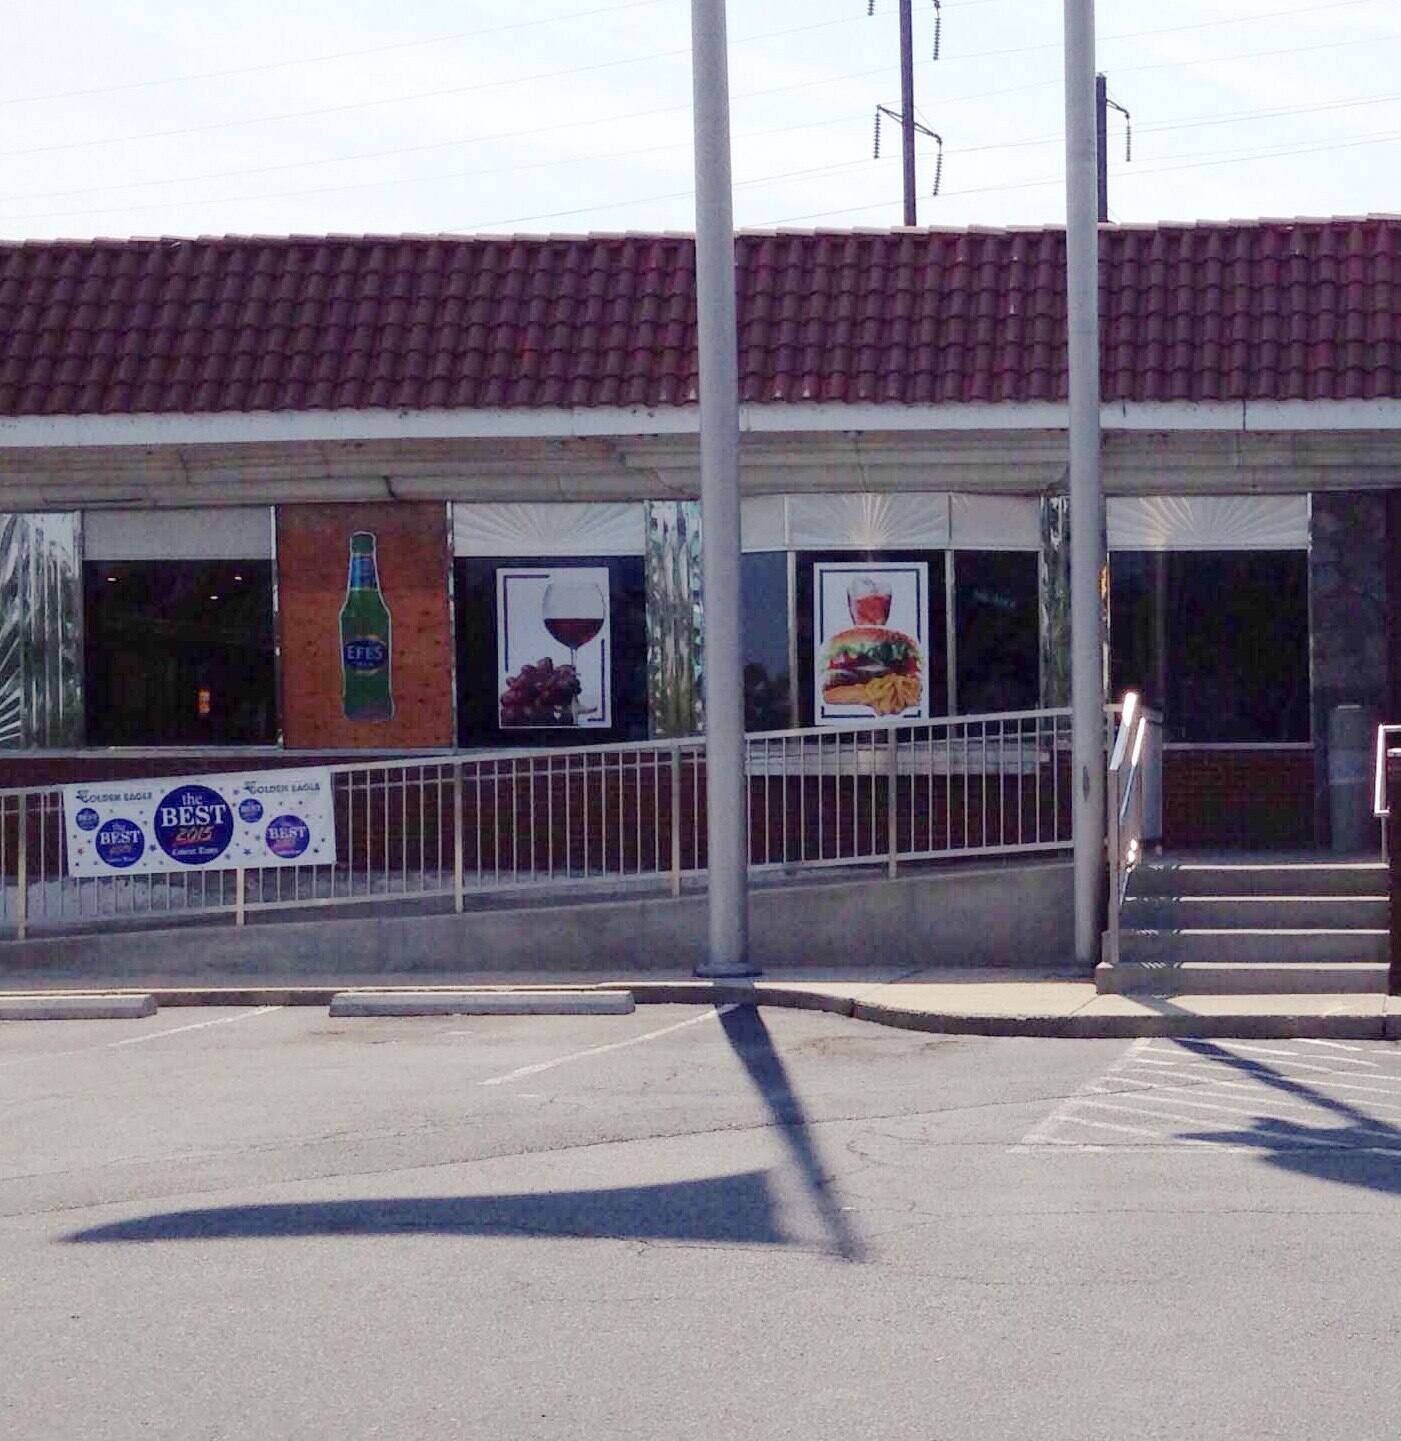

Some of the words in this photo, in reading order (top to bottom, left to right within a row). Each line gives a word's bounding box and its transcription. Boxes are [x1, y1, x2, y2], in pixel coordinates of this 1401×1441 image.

[347, 645, 383, 660] EFES
[182, 792, 203, 806] the
[161, 804, 226, 827] BEST
[101, 830, 140, 844] BEST
[268, 826, 306, 839] BEST
